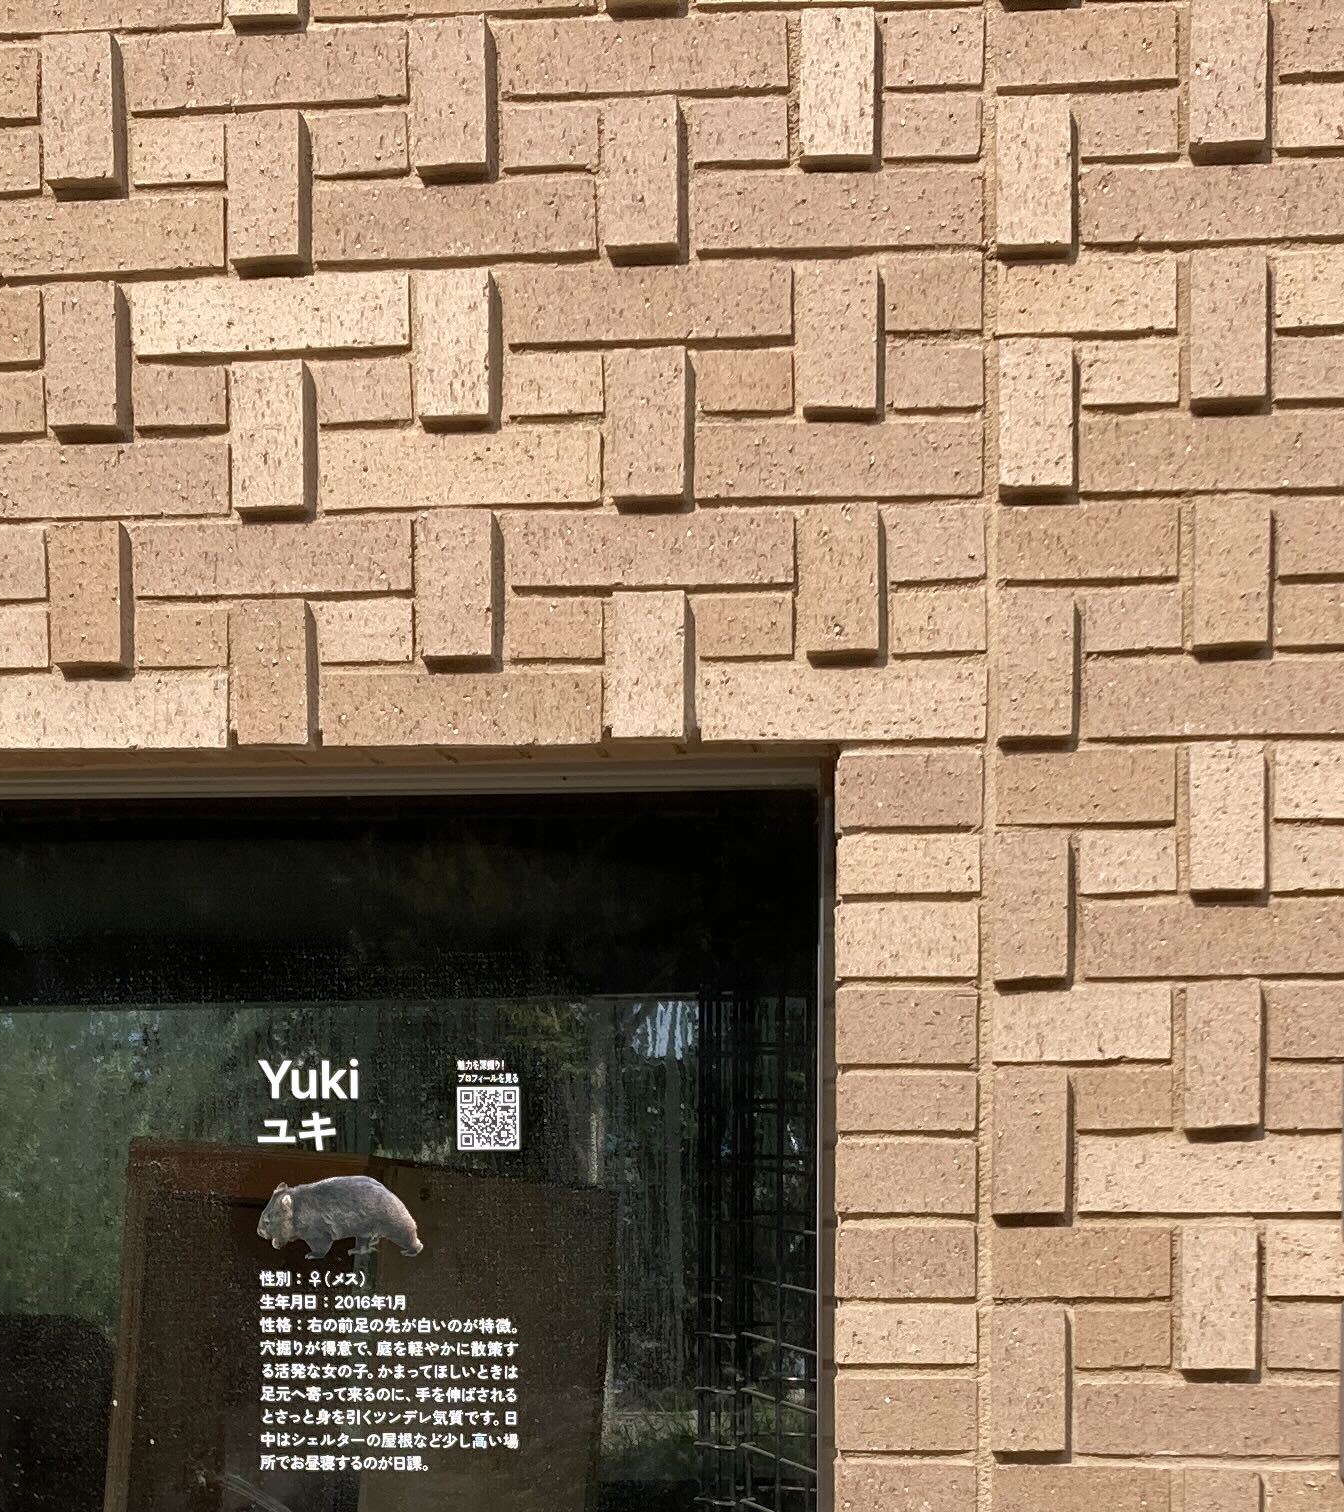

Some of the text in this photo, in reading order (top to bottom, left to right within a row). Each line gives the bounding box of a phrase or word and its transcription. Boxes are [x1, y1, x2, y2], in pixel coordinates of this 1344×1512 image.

[258, 1058, 359, 1100] Yuki
[257, 1112, 337, 1151] ユキ
[259, 1316, 518, 1335] 性格：右の前足の先が白いのが特徴。
[259, 1339, 519, 1358] 穴掘りが得意で、庭を軽やかに散策す
[261, 1362, 519, 1381] る活発な女の子。かまってほしいときは
[259, 1385, 518, 1403] 足元へ寄って来るのに、手を伸ばされる
[261, 1409, 517, 1427] とさっと身を引くツンデレ気質です。日
[260, 1431, 519, 1450] 中はシェルターの屋根など少し高い場
[259, 1454, 429, 1472] 所でお昼寝するのが日課。
